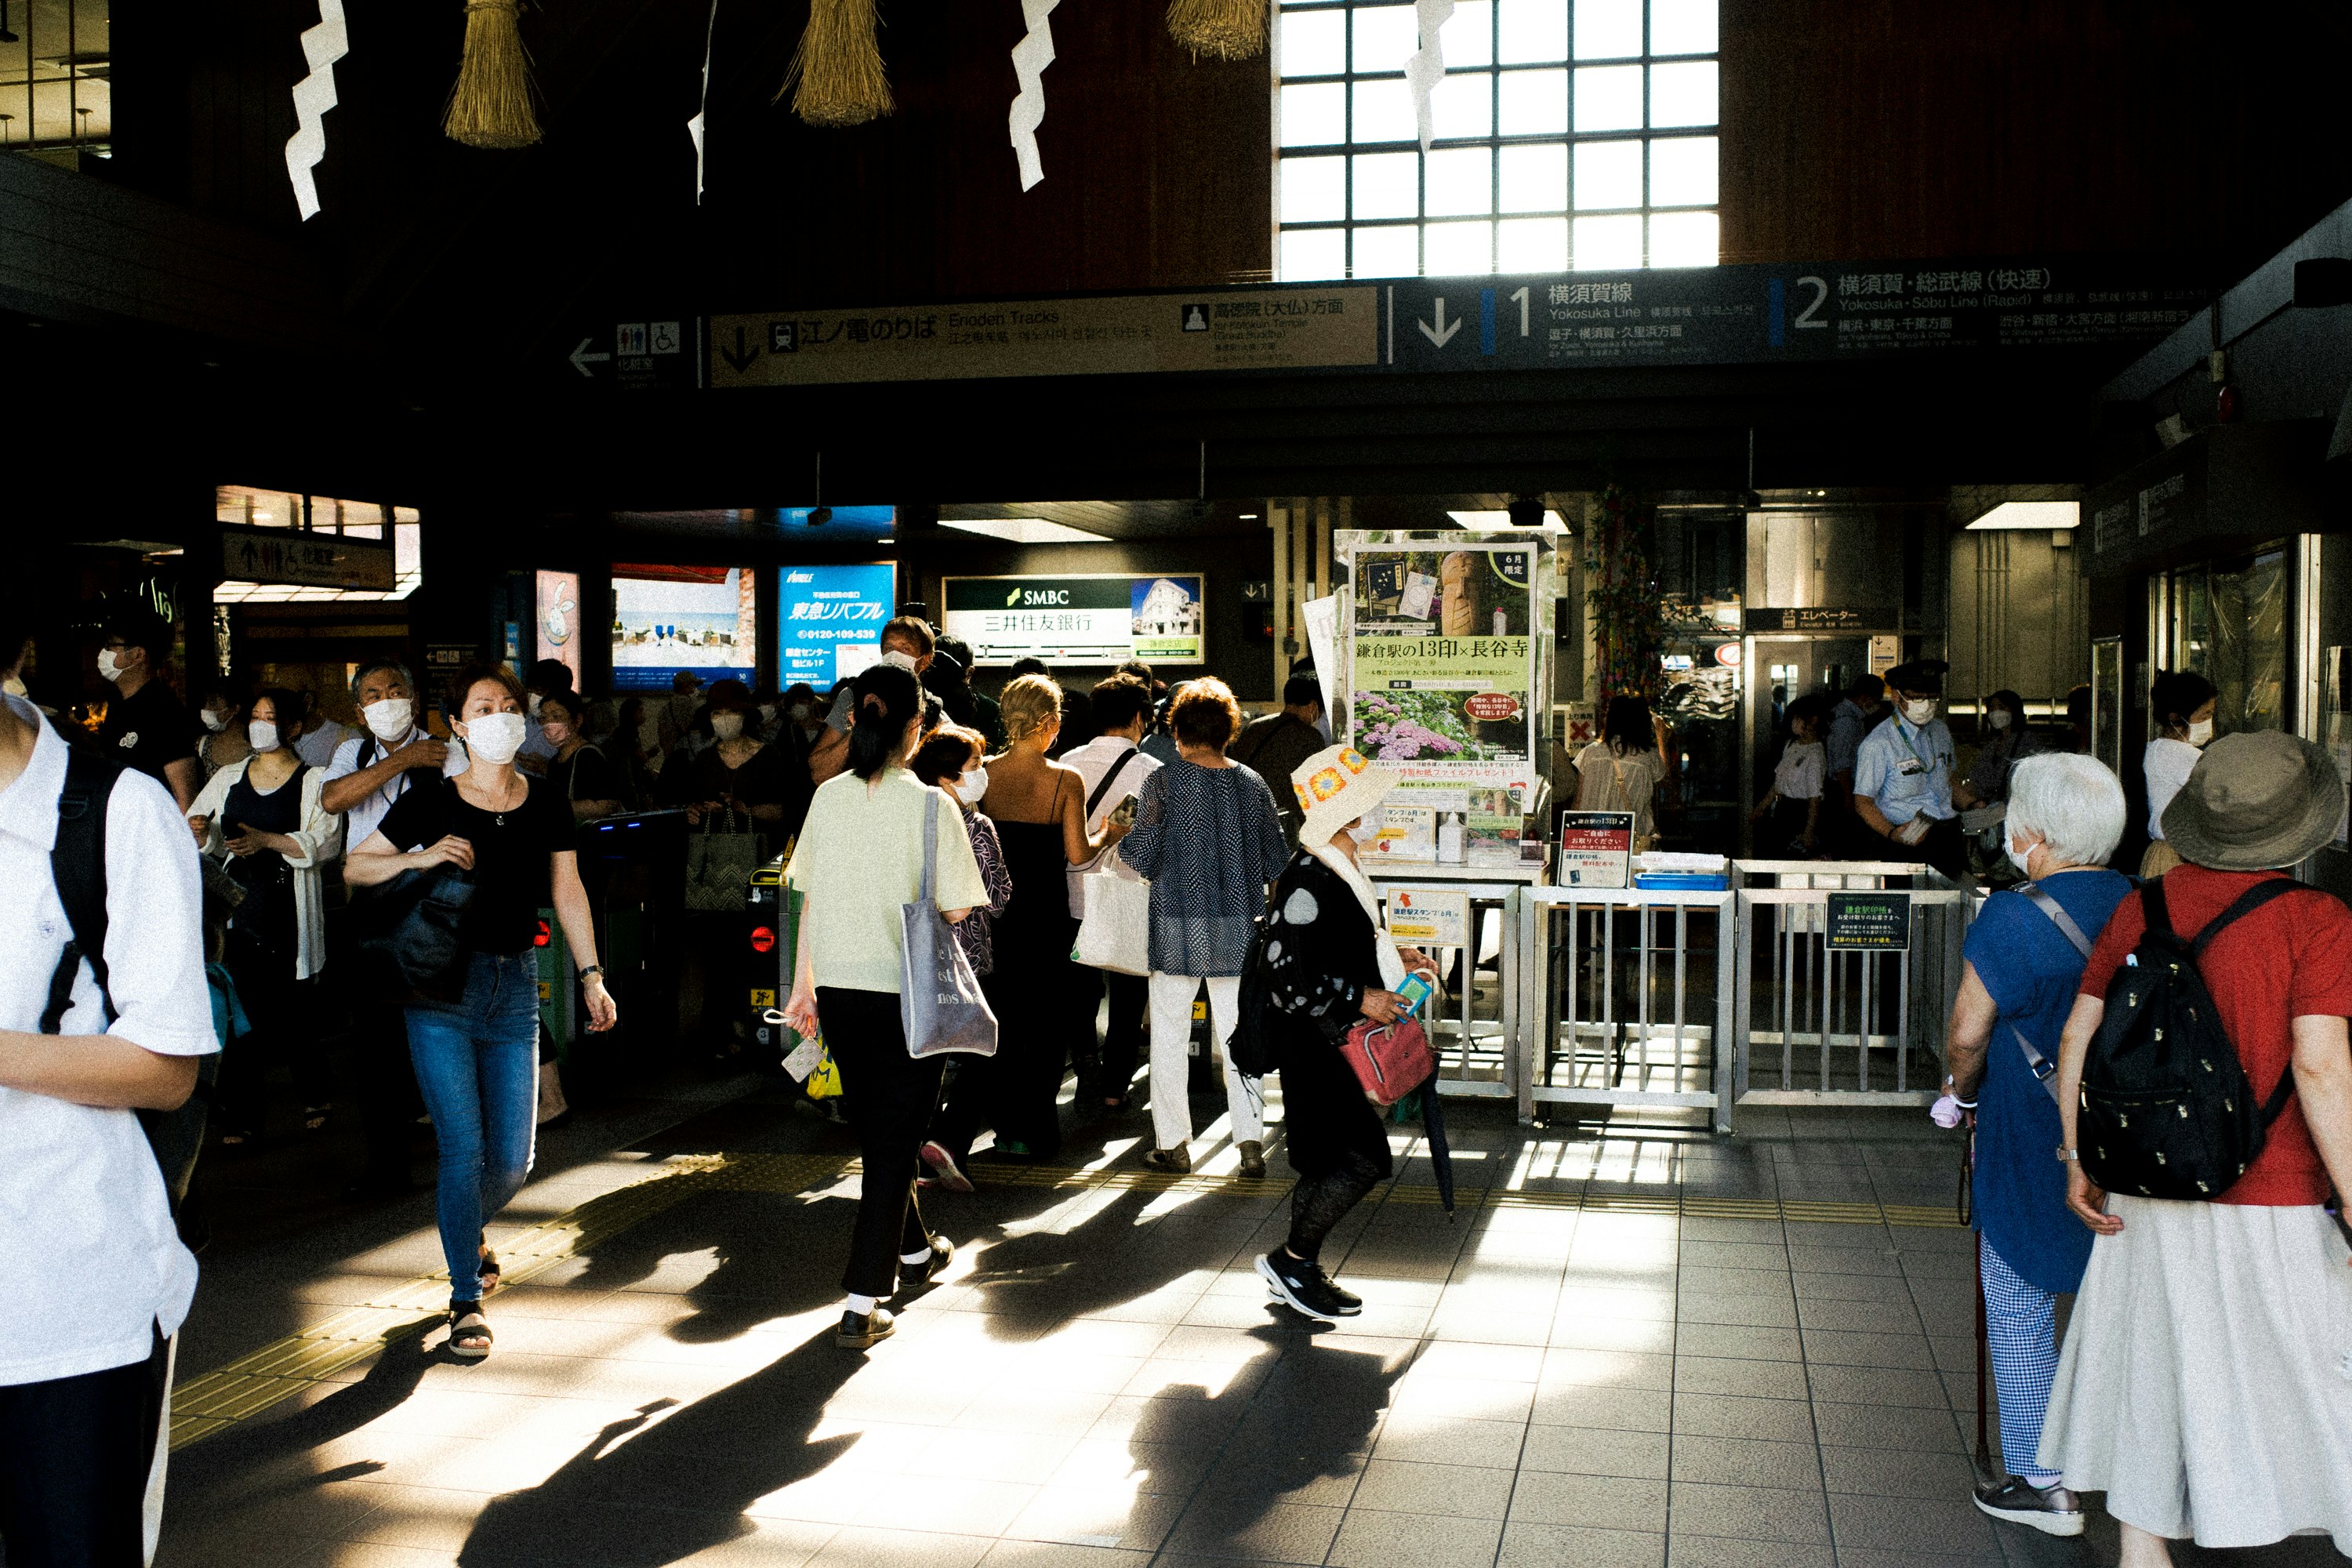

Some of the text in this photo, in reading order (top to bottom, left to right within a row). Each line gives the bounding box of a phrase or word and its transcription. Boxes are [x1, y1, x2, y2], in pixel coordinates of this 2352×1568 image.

[1548, 282, 1632, 305] 横須賀線
[1950, 296, 1979, 308] Line
[1983, 293, 2032, 307] (Rapid)
[1795, 276, 1828, 328] 2
[1510, 286, 1529, 336] 1
[1549, 309, 1610, 320] Yokosuka
[1614, 307, 1642, 318] Line
[949, 311, 1058, 327] Enoden Tracks
[801, 314, 937, 344] 江ノ電のりば
[1504, 565, 1523, 575] 限定
[1024, 590, 1069, 605] SMBC
[1260, 583, 1267, 598] 1
[789, 602, 885, 619] 東急リバブル
[1801, 611, 1857, 620] エレベーター
[985, 615, 1091, 632] 三井住友銀行
[1356, 639, 1527, 659] 鎌倉駅の13印×長谷寺
[1846, 906, 1893, 914] 鎌倉駅印帳を
[938, 993, 959, 1004] nos
